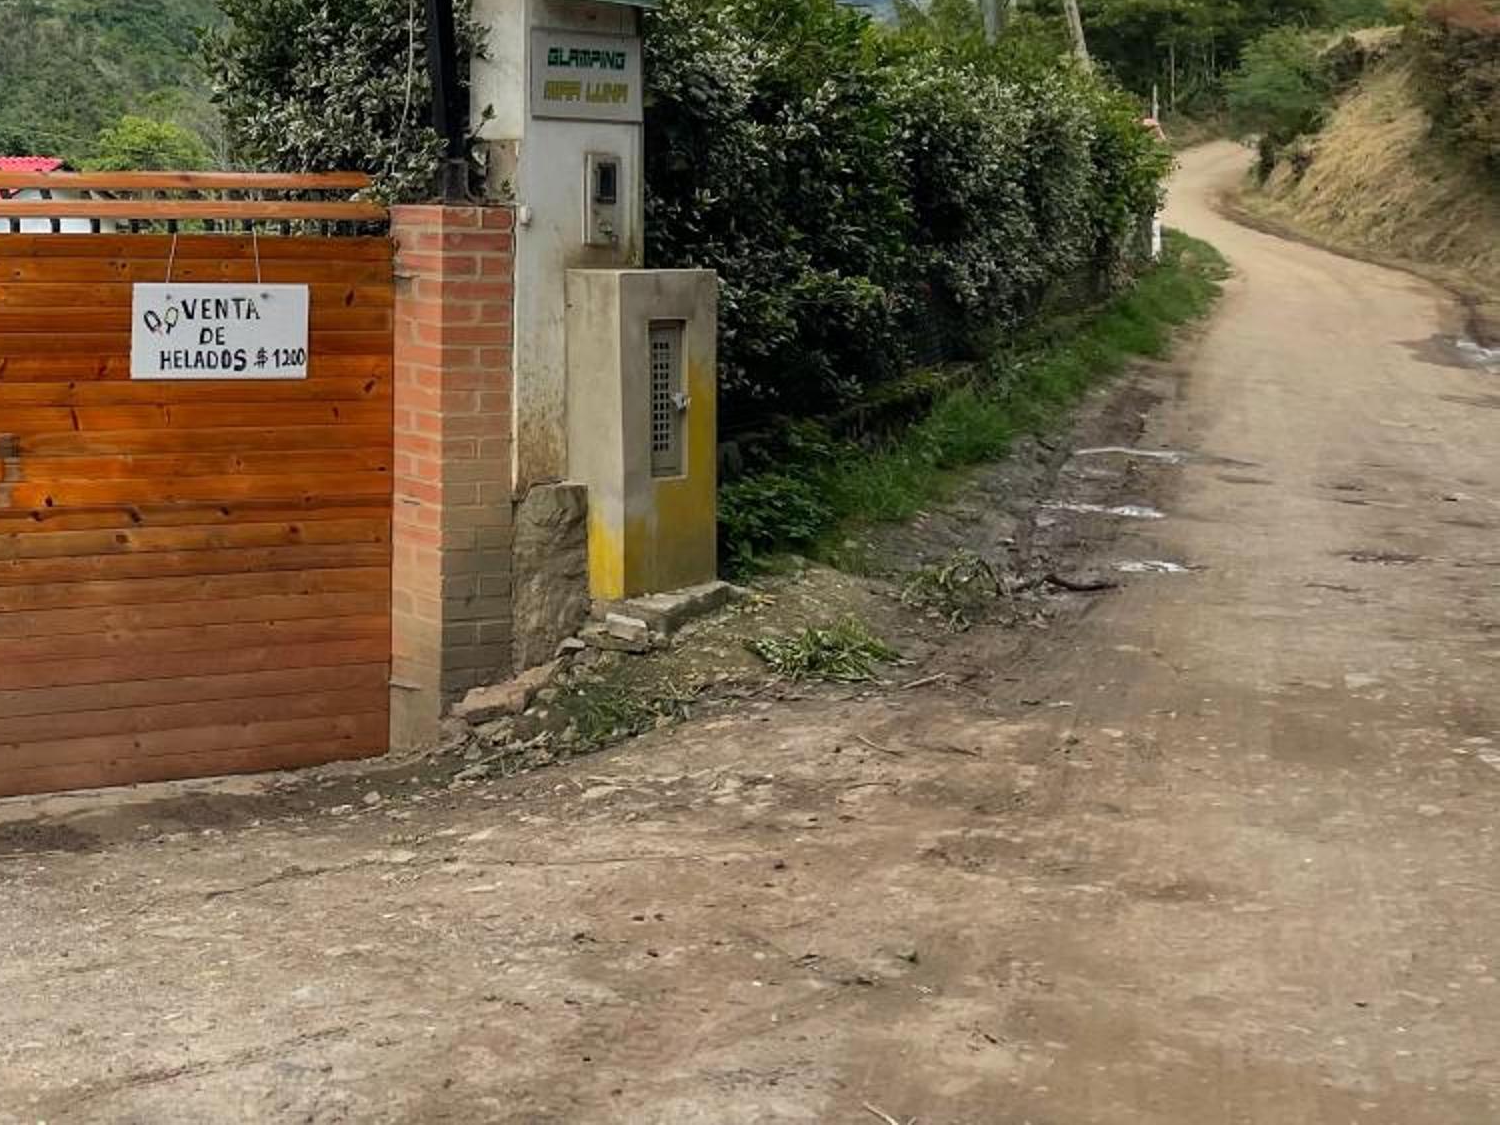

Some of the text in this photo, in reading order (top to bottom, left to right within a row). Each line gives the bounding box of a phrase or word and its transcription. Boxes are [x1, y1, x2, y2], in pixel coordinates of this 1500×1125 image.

[181, 297, 261, 321] VENTA
[198, 326, 226, 346] DE
[159, 348, 248, 372] HELADOS
